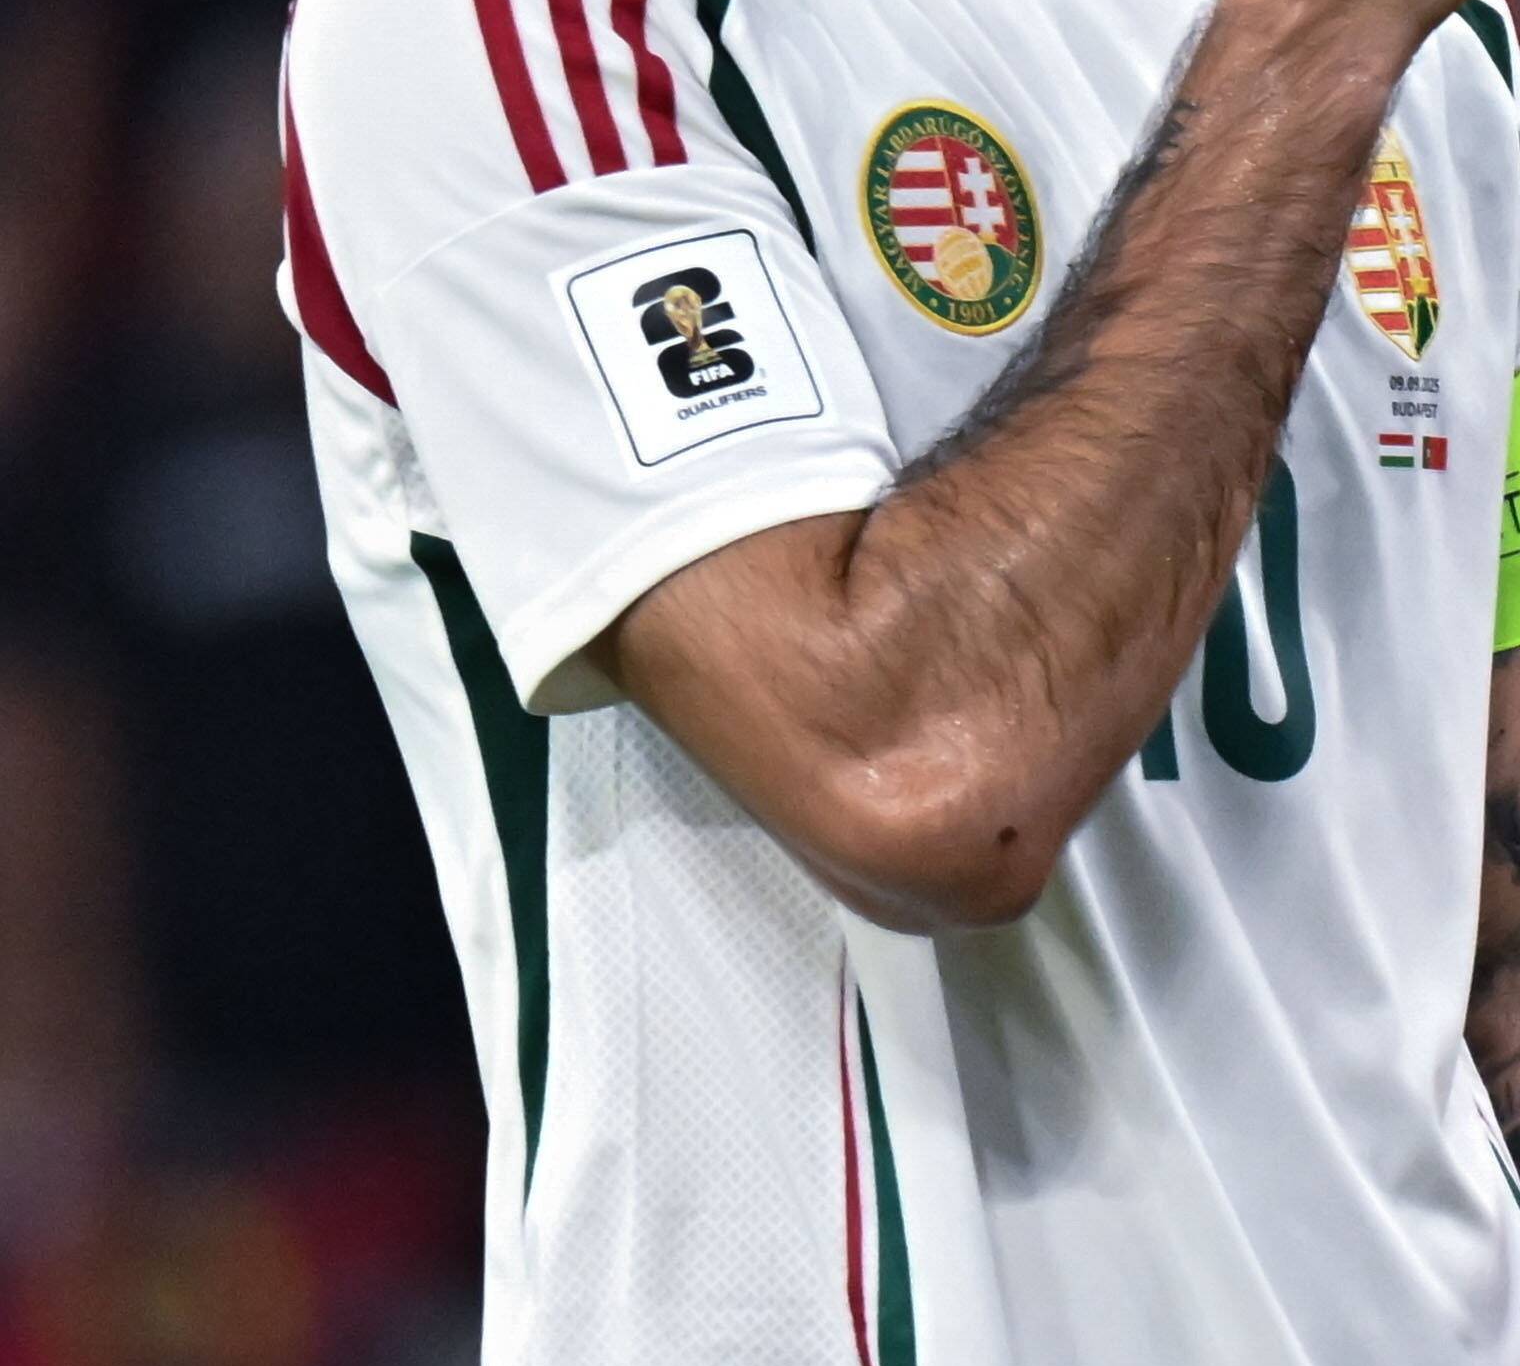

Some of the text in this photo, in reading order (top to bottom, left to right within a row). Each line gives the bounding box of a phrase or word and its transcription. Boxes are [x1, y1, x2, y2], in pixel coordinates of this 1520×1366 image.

[948, 301, 998, 325] 1901
[689, 363, 735, 386] FIFA
[677, 385, 767, 420] QUALIFIERS
